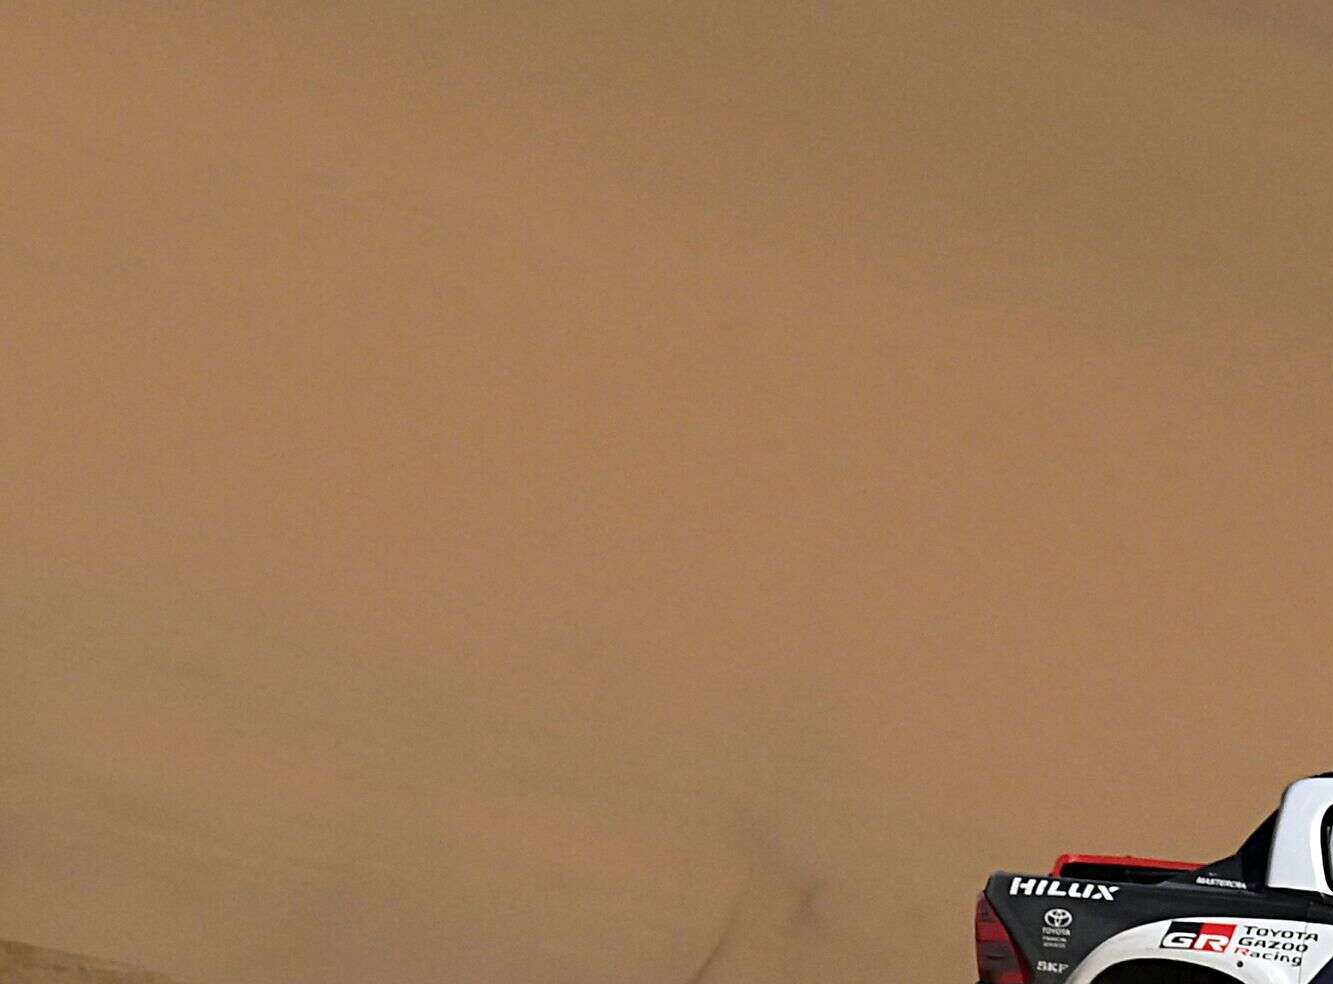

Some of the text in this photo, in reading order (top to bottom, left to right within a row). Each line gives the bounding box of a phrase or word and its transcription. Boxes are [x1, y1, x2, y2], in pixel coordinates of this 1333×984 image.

[1009, 877, 1120, 901] HILUX
[1161, 931, 1232, 954] GR
[1243, 925, 1319, 942] TOYOTA
[1238, 936, 1309, 953] GAZOO
[1234, 947, 1303, 967] Racing
[1037, 960, 1070, 974] SKF
